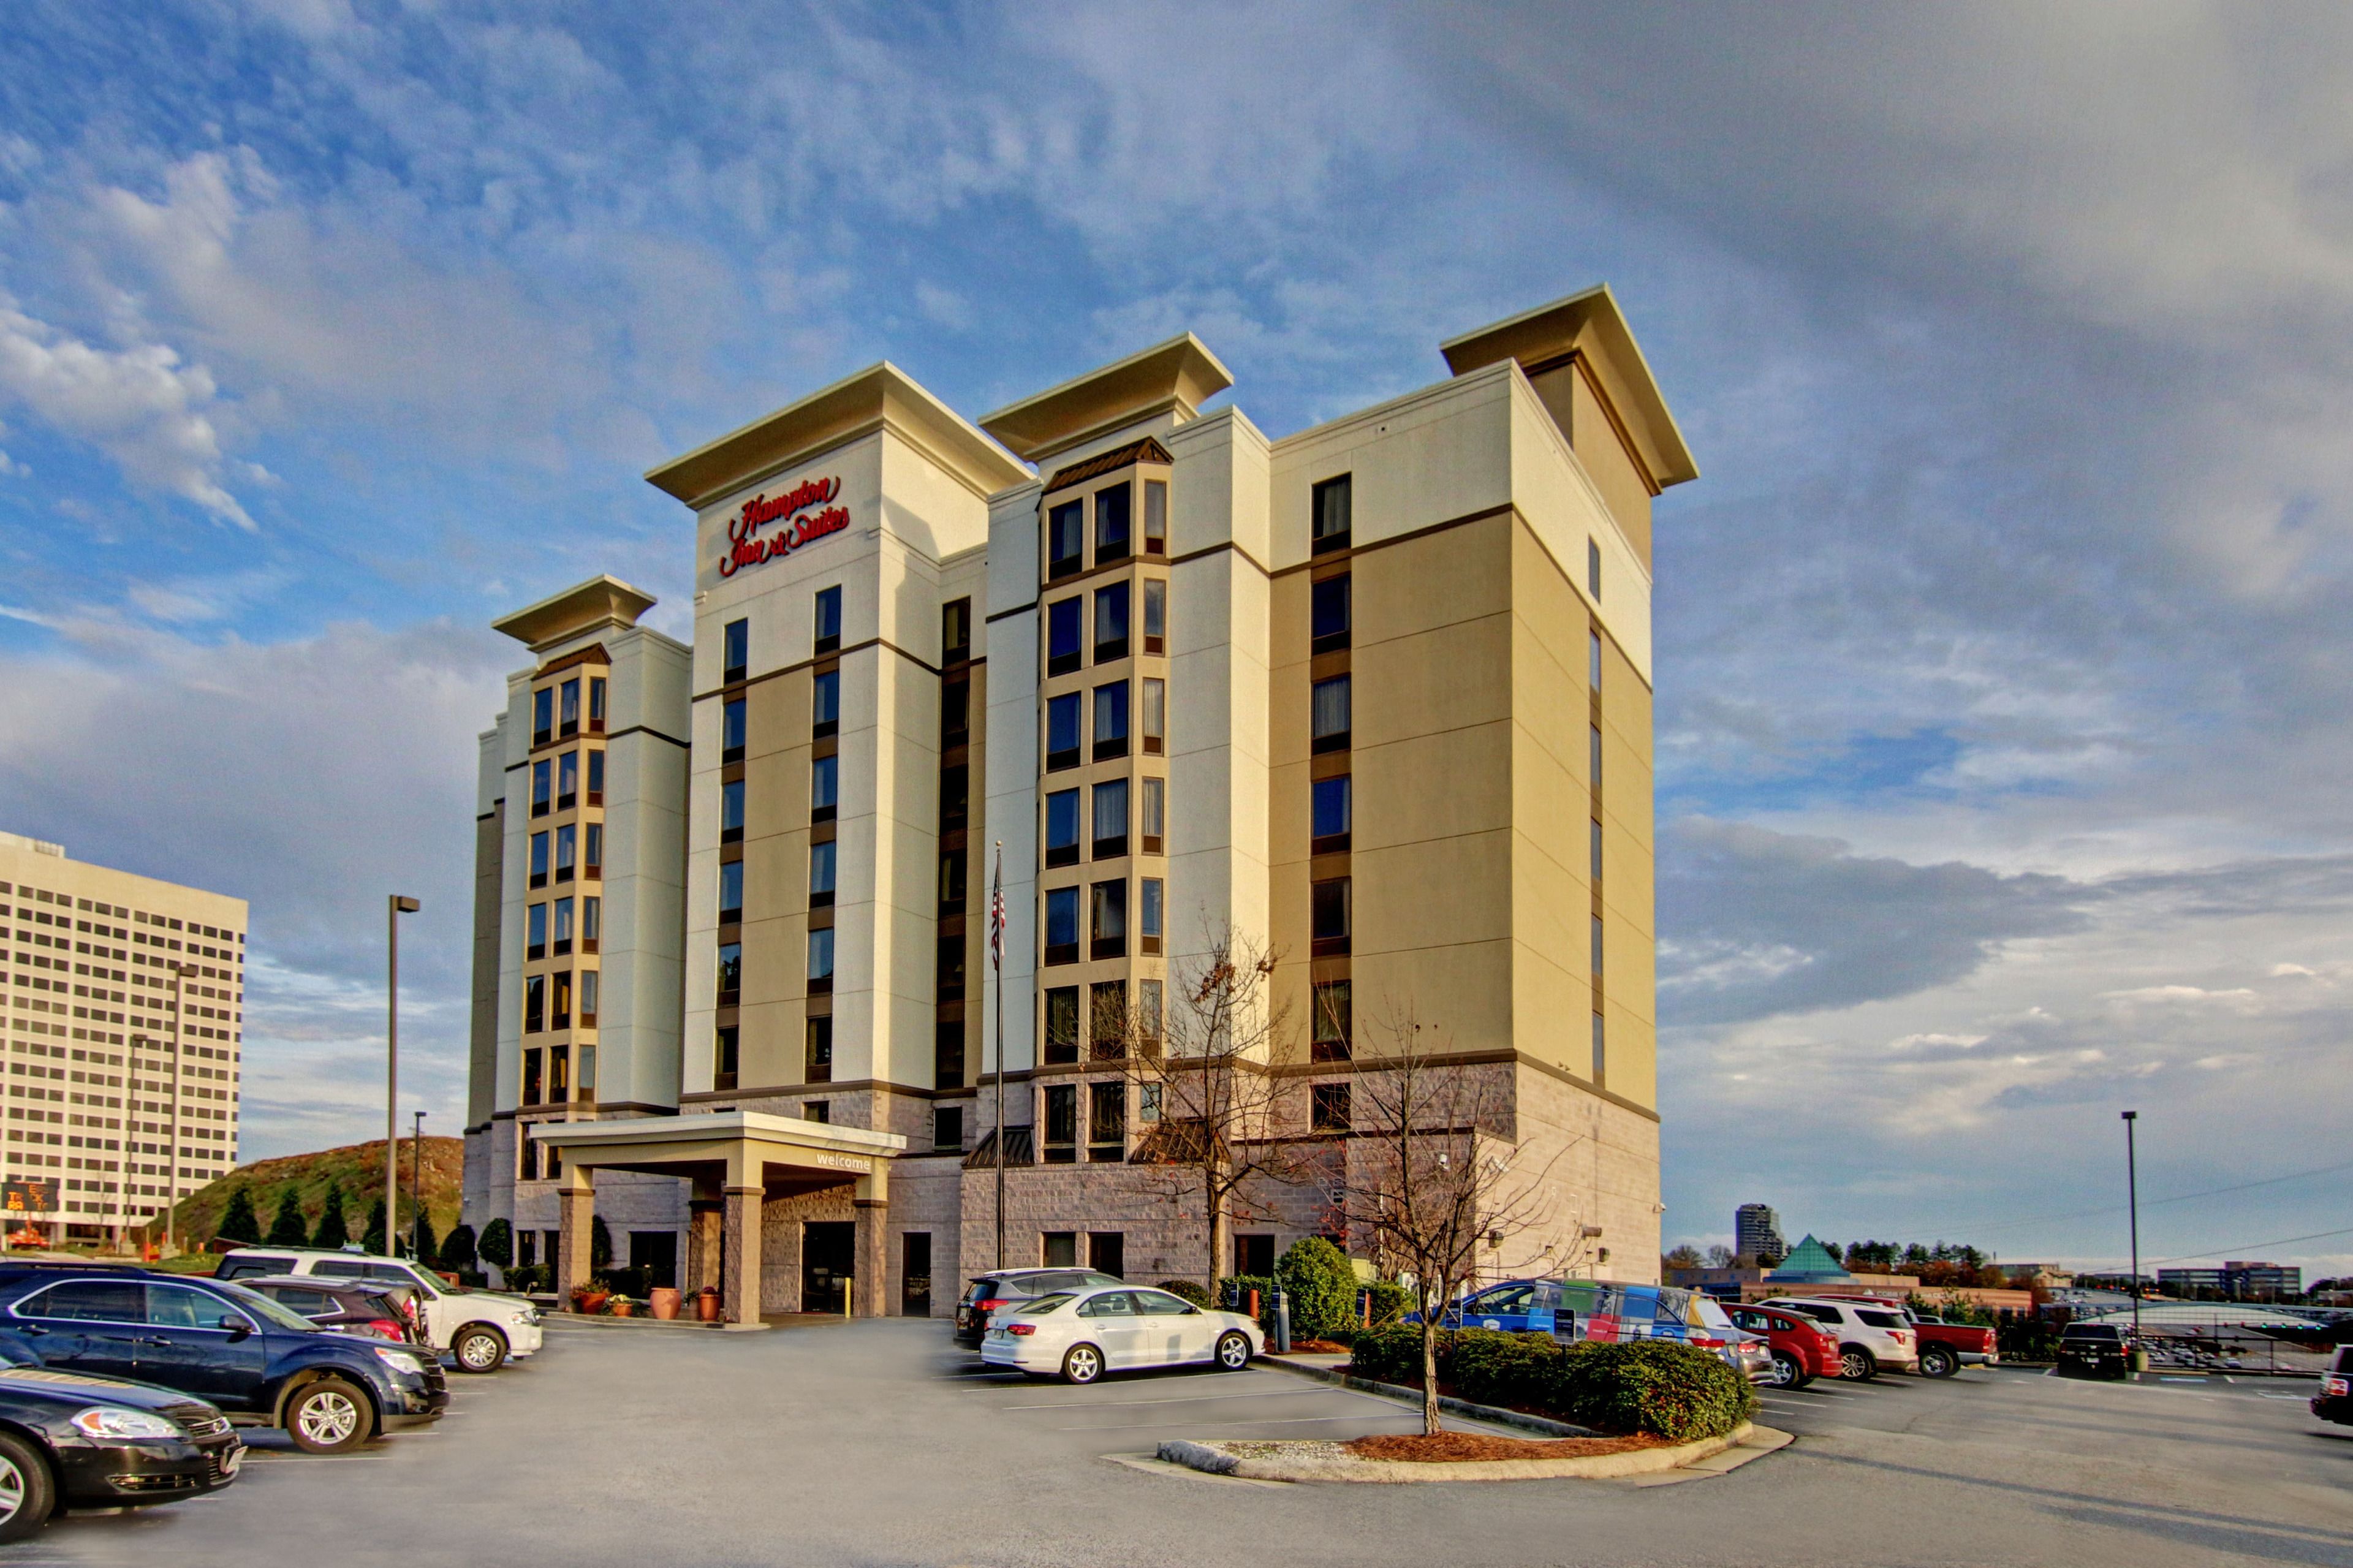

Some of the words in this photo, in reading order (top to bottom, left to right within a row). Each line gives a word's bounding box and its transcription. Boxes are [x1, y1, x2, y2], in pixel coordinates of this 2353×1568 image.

[719, 537, 773, 577] Inn
[771, 531, 790, 556] &
[785, 506, 850, 548] Suites
[729, 476, 841, 544] Hampton
[816, 1153, 871, 1170] welcome
